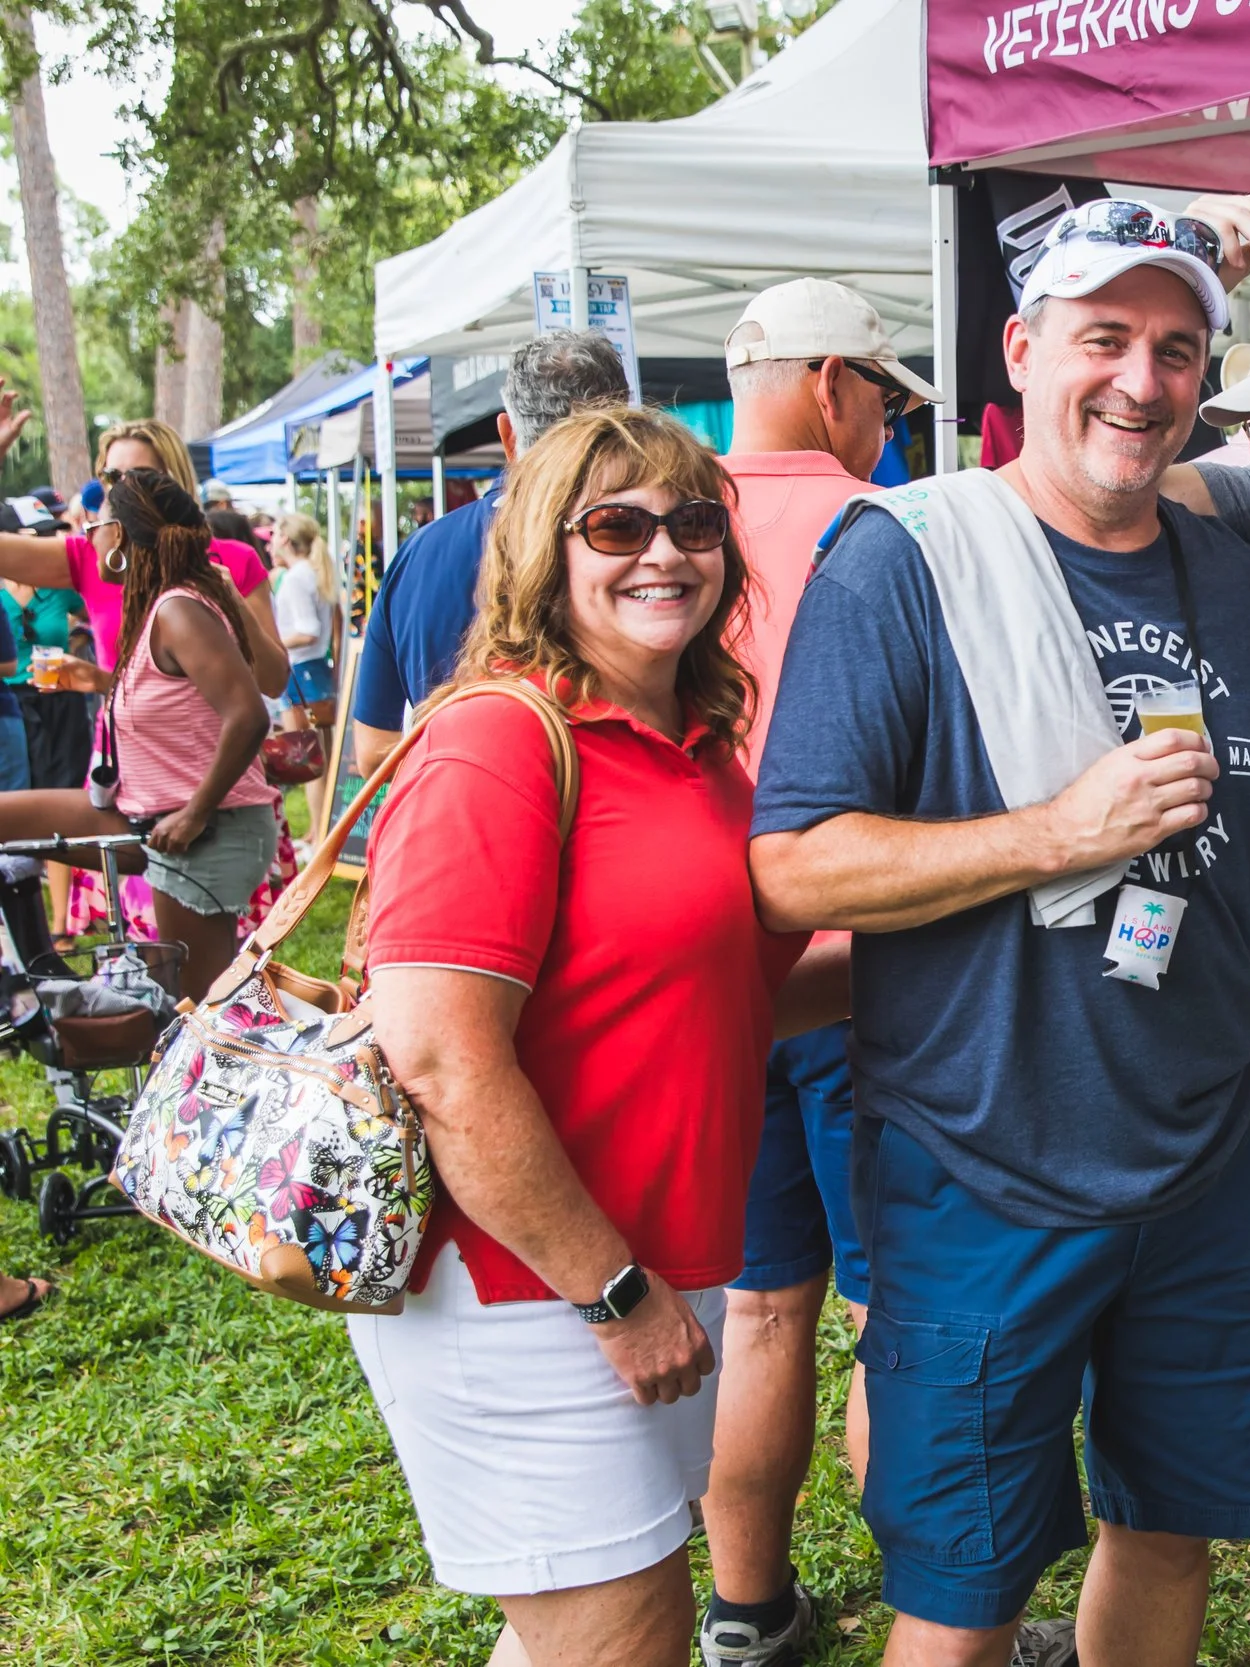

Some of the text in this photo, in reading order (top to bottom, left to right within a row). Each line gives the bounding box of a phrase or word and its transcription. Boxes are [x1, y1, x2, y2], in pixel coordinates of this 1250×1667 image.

[1085, 621, 1230, 700] NEGEIST
[1118, 923, 1170, 951] HOP
[1123, 914, 1173, 934] ISLAND
